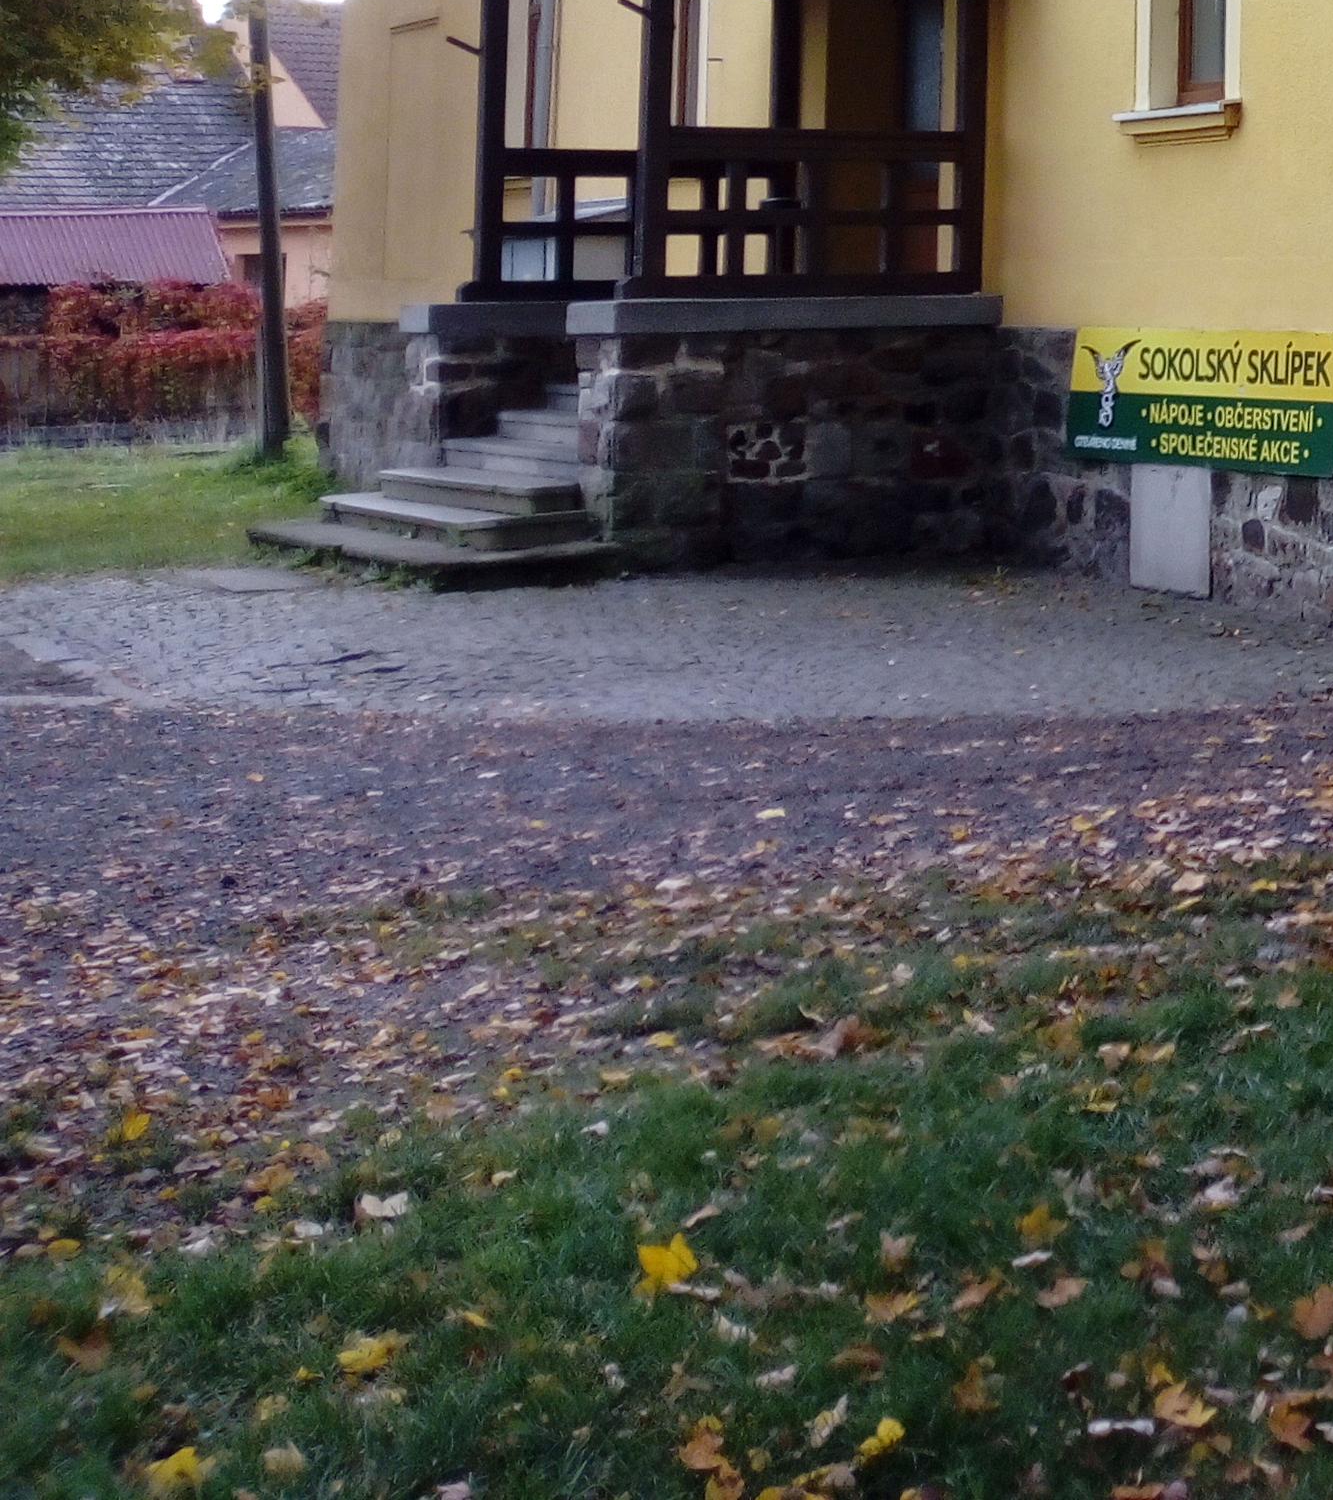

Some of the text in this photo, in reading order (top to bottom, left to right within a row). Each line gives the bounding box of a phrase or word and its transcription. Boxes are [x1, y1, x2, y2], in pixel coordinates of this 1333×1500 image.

[1138, 340, 1333, 387] SOKOLSKÝ SKLÍPEK
[1150, 399, 1315, 433] NÁPOJE OBČERSTVENÍ
[1159, 431, 1300, 464] SPOLEČENSKÉ AKCE
